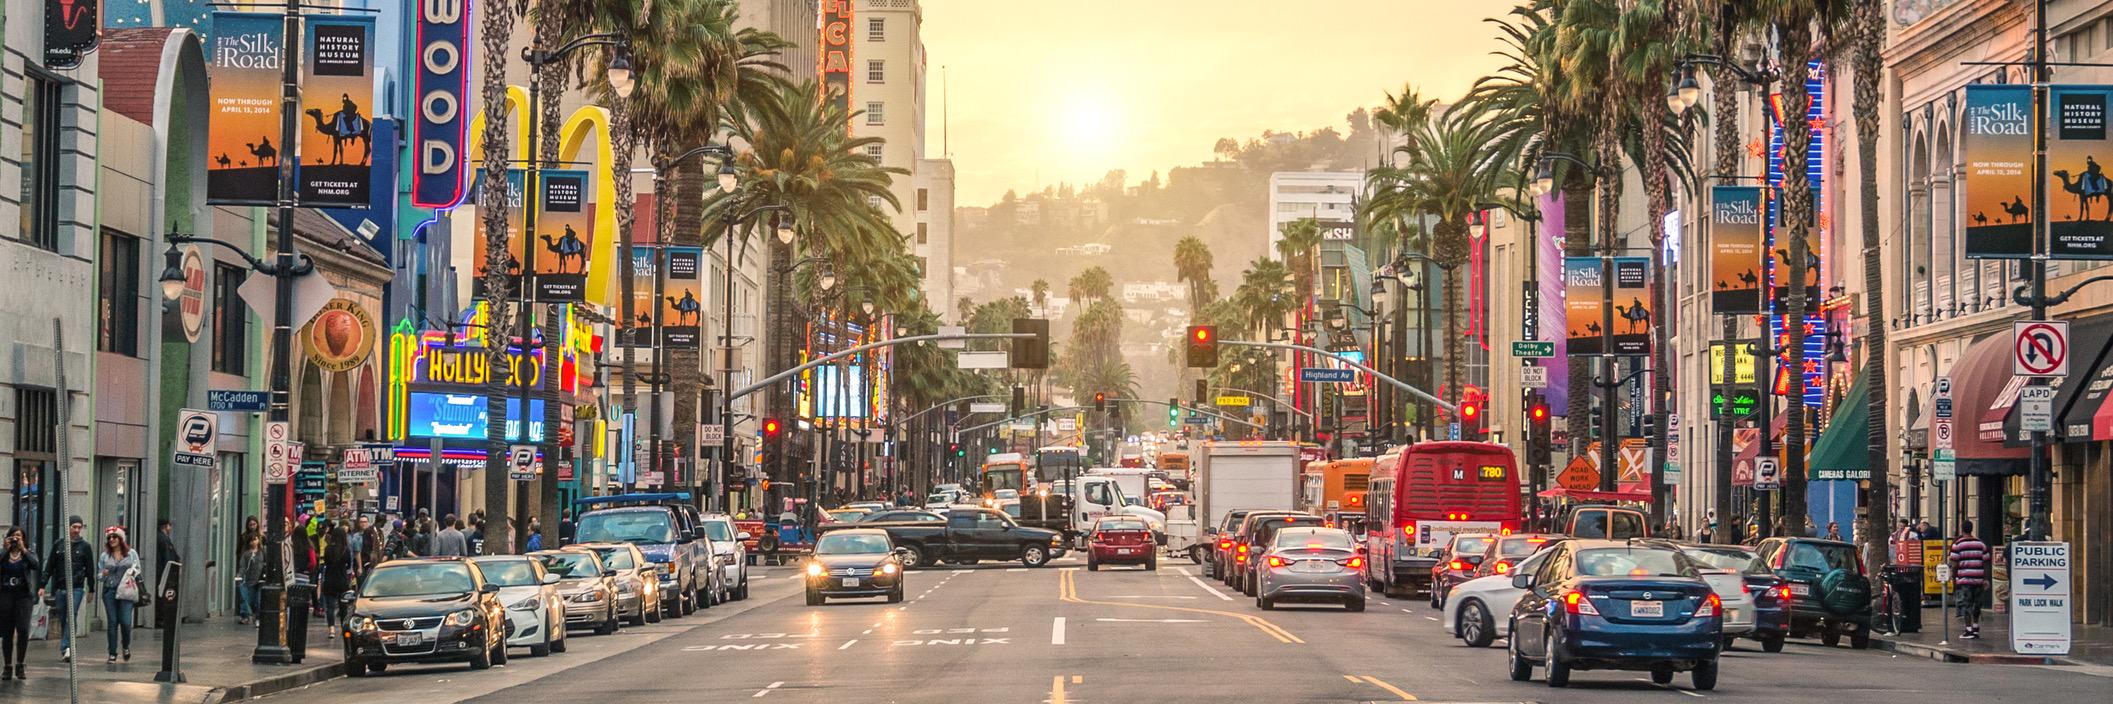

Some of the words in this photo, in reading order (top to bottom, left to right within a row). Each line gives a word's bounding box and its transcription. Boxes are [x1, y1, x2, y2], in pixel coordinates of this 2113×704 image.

[224, 36, 240, 46] The
[240, 32, 275, 53] Silk
[223, 46, 279, 69] Road
[1978, 106, 1991, 116] The
[1991, 102, 2022, 120] Silk
[1977, 115, 2028, 135] Road
[1730, 200, 1752, 214] Silk
[1720, 209, 1758, 224] Road
[1580, 267, 1598, 278] Silk
[1572, 274, 1600, 287] Road
[347, 302, 370, 328] KING
[312, 354, 336, 369] Since
[340, 356, 360, 370] 1989
[1305, 371, 1337, 379] Highland
[210, 392, 258, 402] McCadden
[176, 456, 191, 464] PAY
[193, 457, 212, 466] HERE
[346, 448, 370, 462] ATM
[1454, 470, 1463, 479] M
[1482, 466, 1501, 477] 780
[1818, 470, 1844, 479] CAMERAS
[475, 543, 482, 554] 5
[2016, 547, 2065, 556] PUBLIC
[2014, 558, 2066, 567] PARKING
